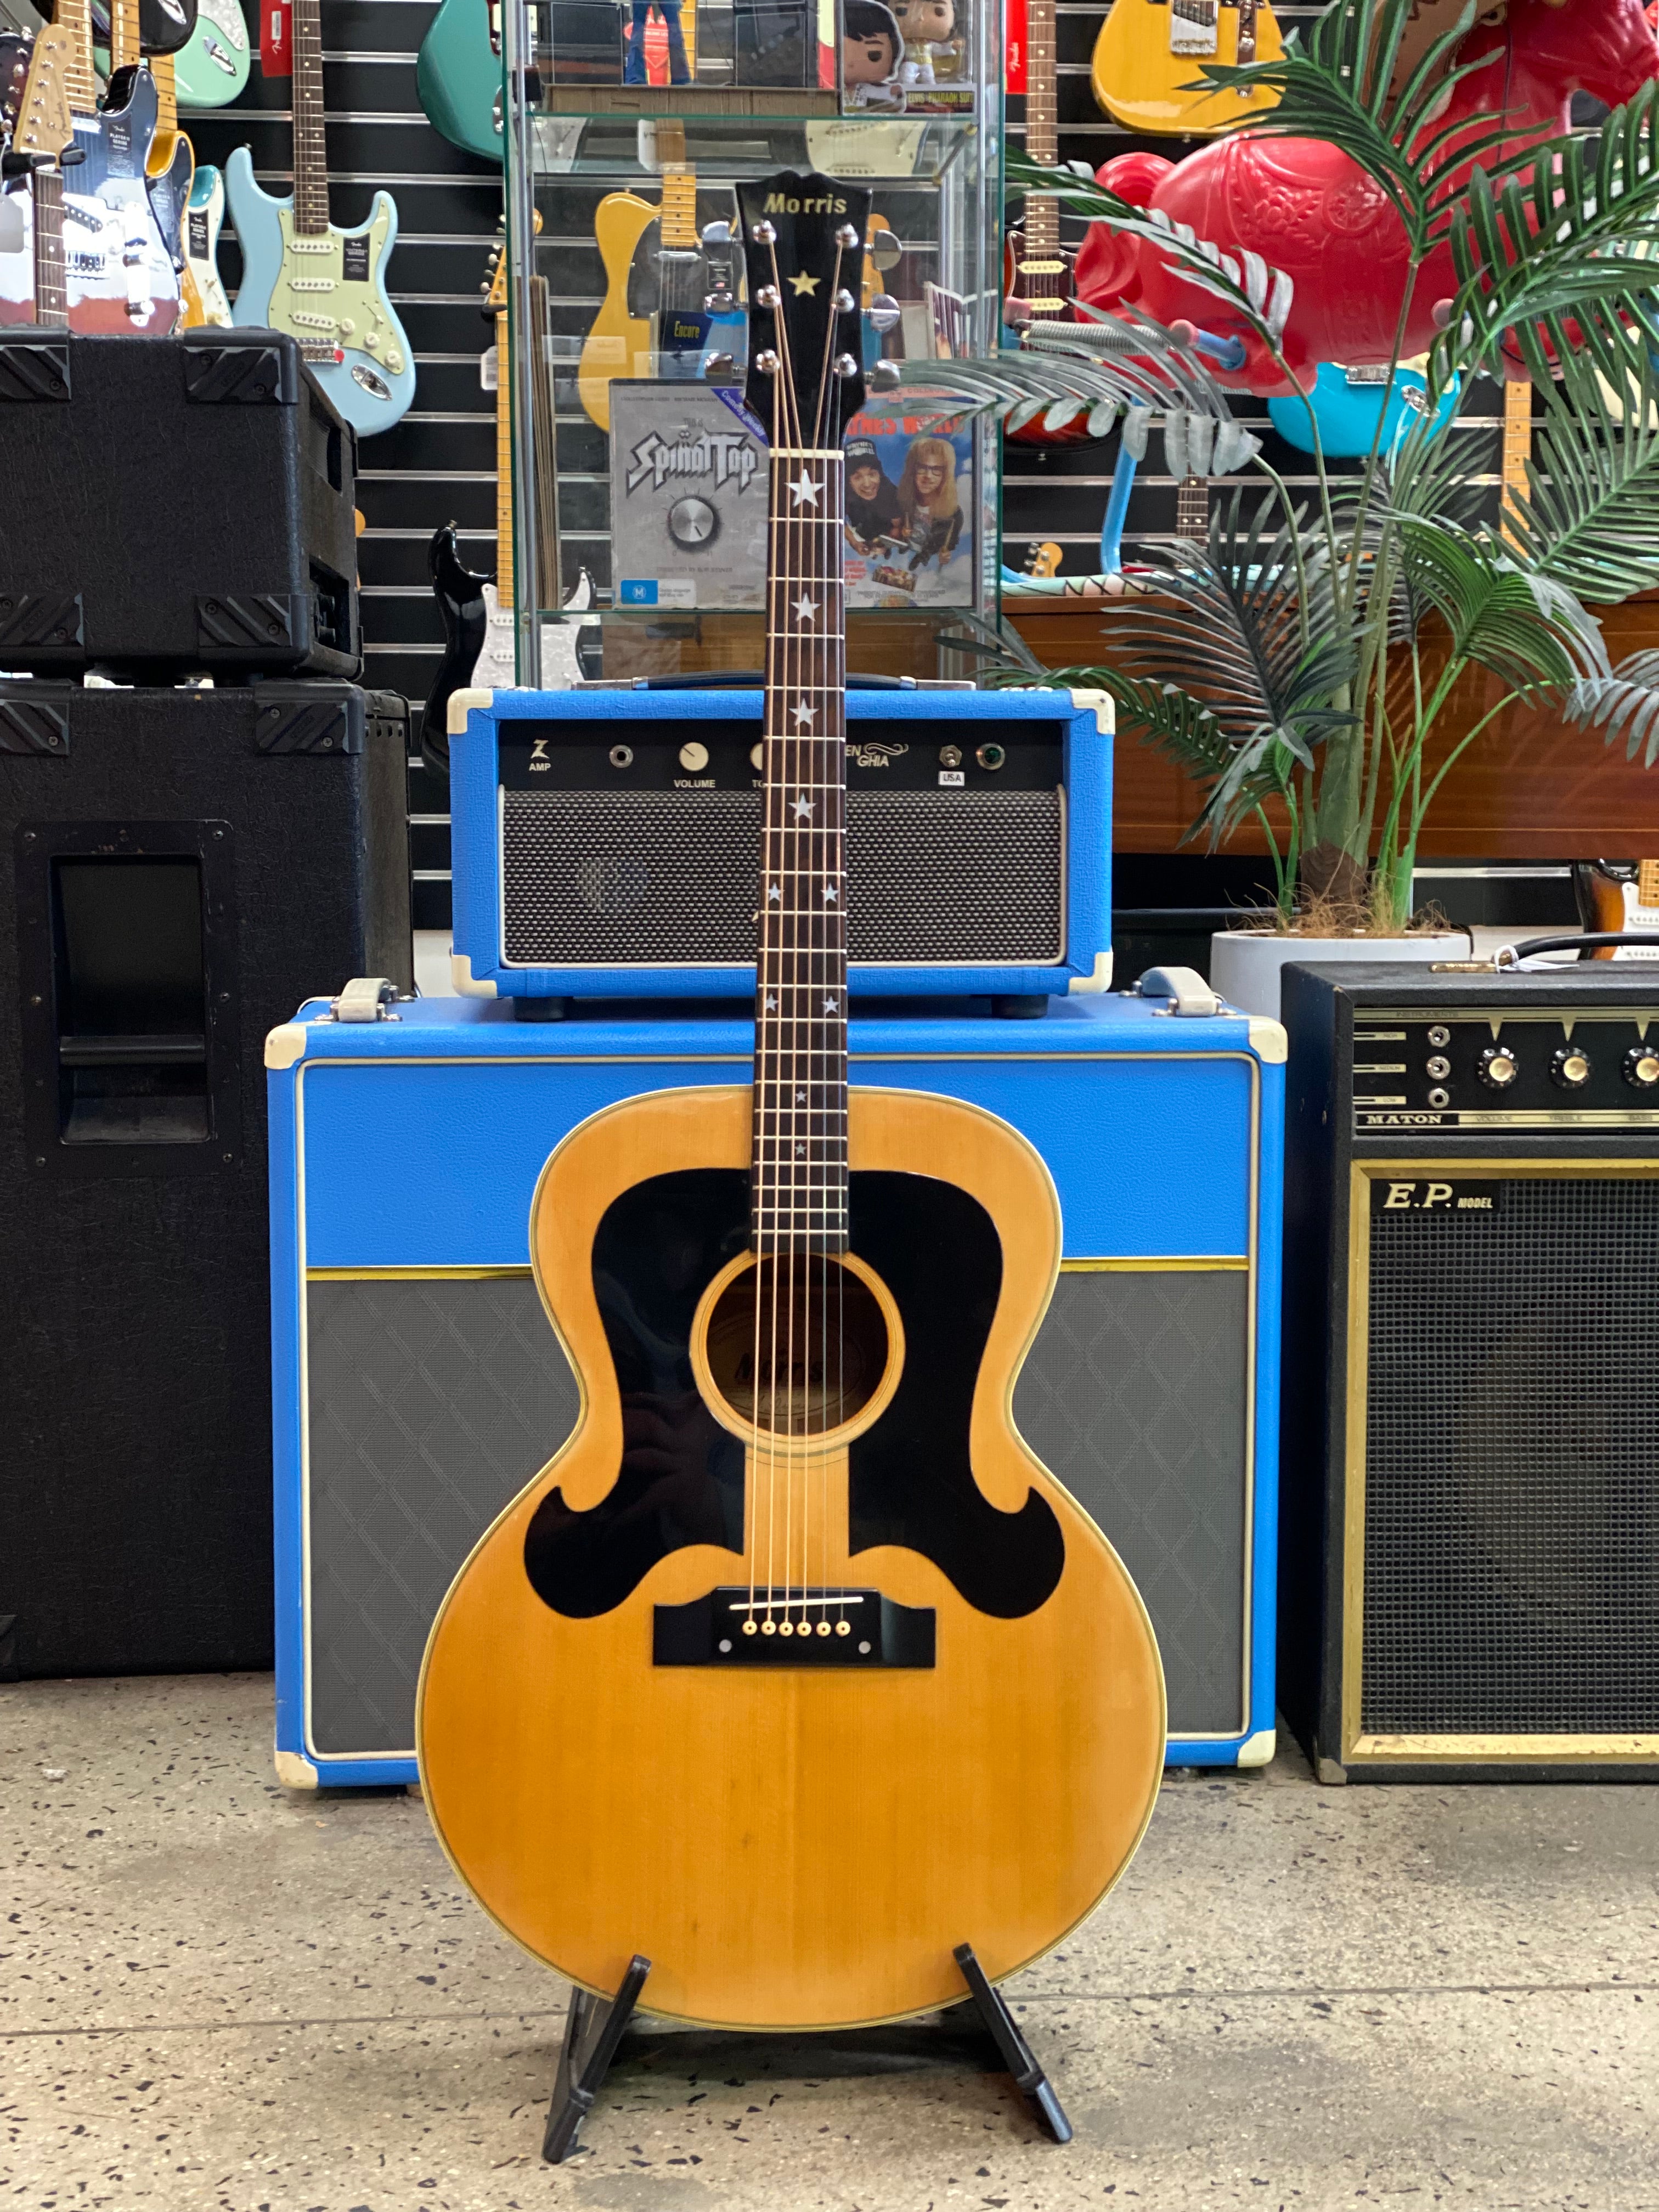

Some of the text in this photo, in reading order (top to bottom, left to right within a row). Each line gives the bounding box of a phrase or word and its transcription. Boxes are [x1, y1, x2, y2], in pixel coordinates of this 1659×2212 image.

[763, 193, 847, 214] Morris
[674, 321, 700, 338] Encore
[857, 755, 889, 767] GHIA
[529, 763, 551, 771] AMP
[943, 774, 961, 782] USA
[673, 779, 715, 788] VOLUME
[1366, 1115, 1442, 1124] MATON
[1382, 1183, 1493, 1209] E.P. MODEL
